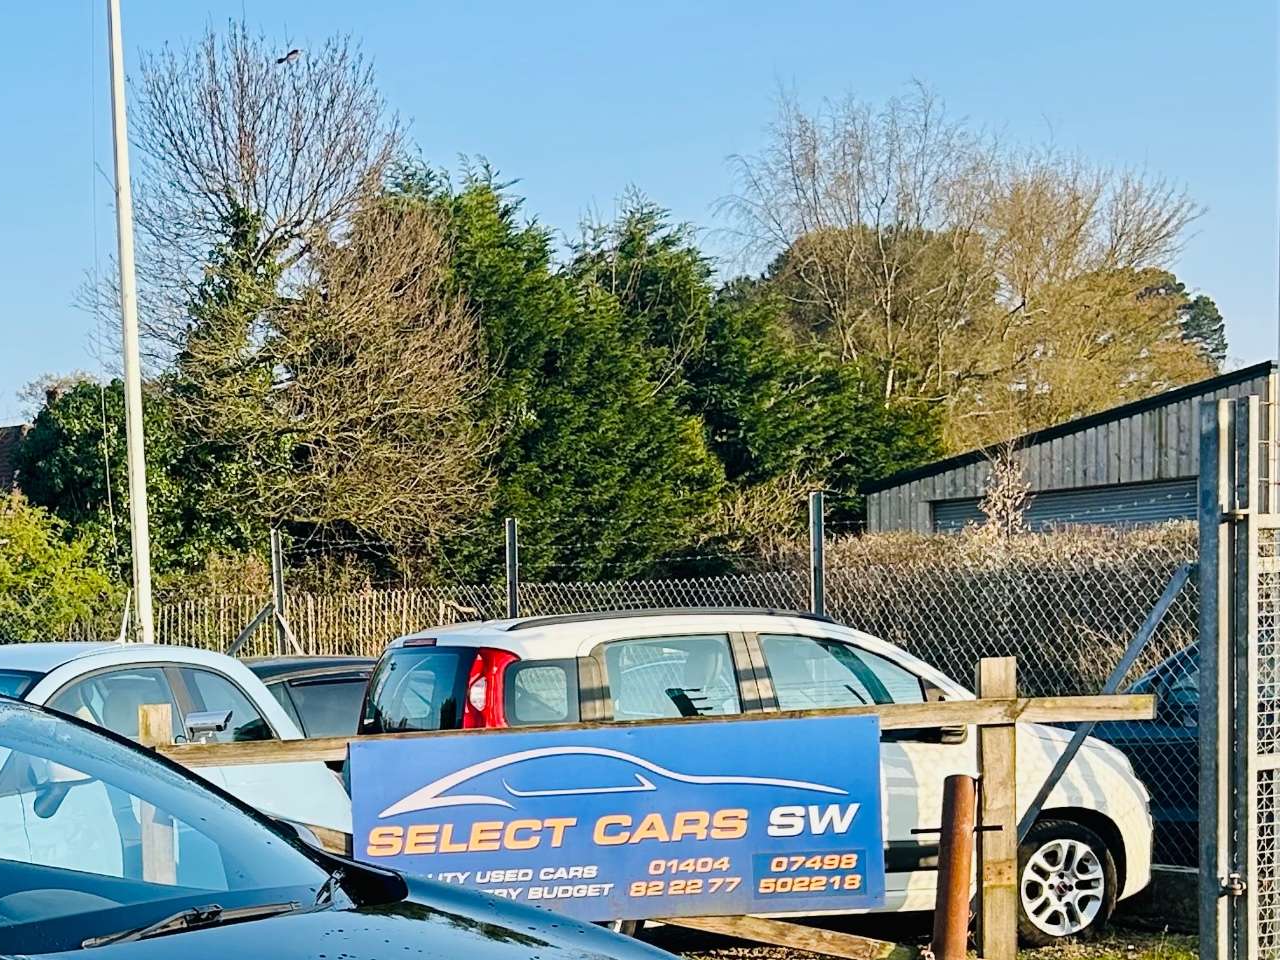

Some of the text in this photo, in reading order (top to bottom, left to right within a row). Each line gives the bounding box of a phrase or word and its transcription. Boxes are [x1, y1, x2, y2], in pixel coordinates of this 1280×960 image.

[366, 803, 861, 857] SELECT CARS SW
[648, 856, 731, 875] 01404
[770, 853, 859, 872] 07498
[475, 868, 533, 883] USED
[538, 865, 598, 881] CARS
[527, 883, 615, 900] BUDGET
[629, 876, 742, 897] 82 22 77
[758, 874, 862, 894] 502218
